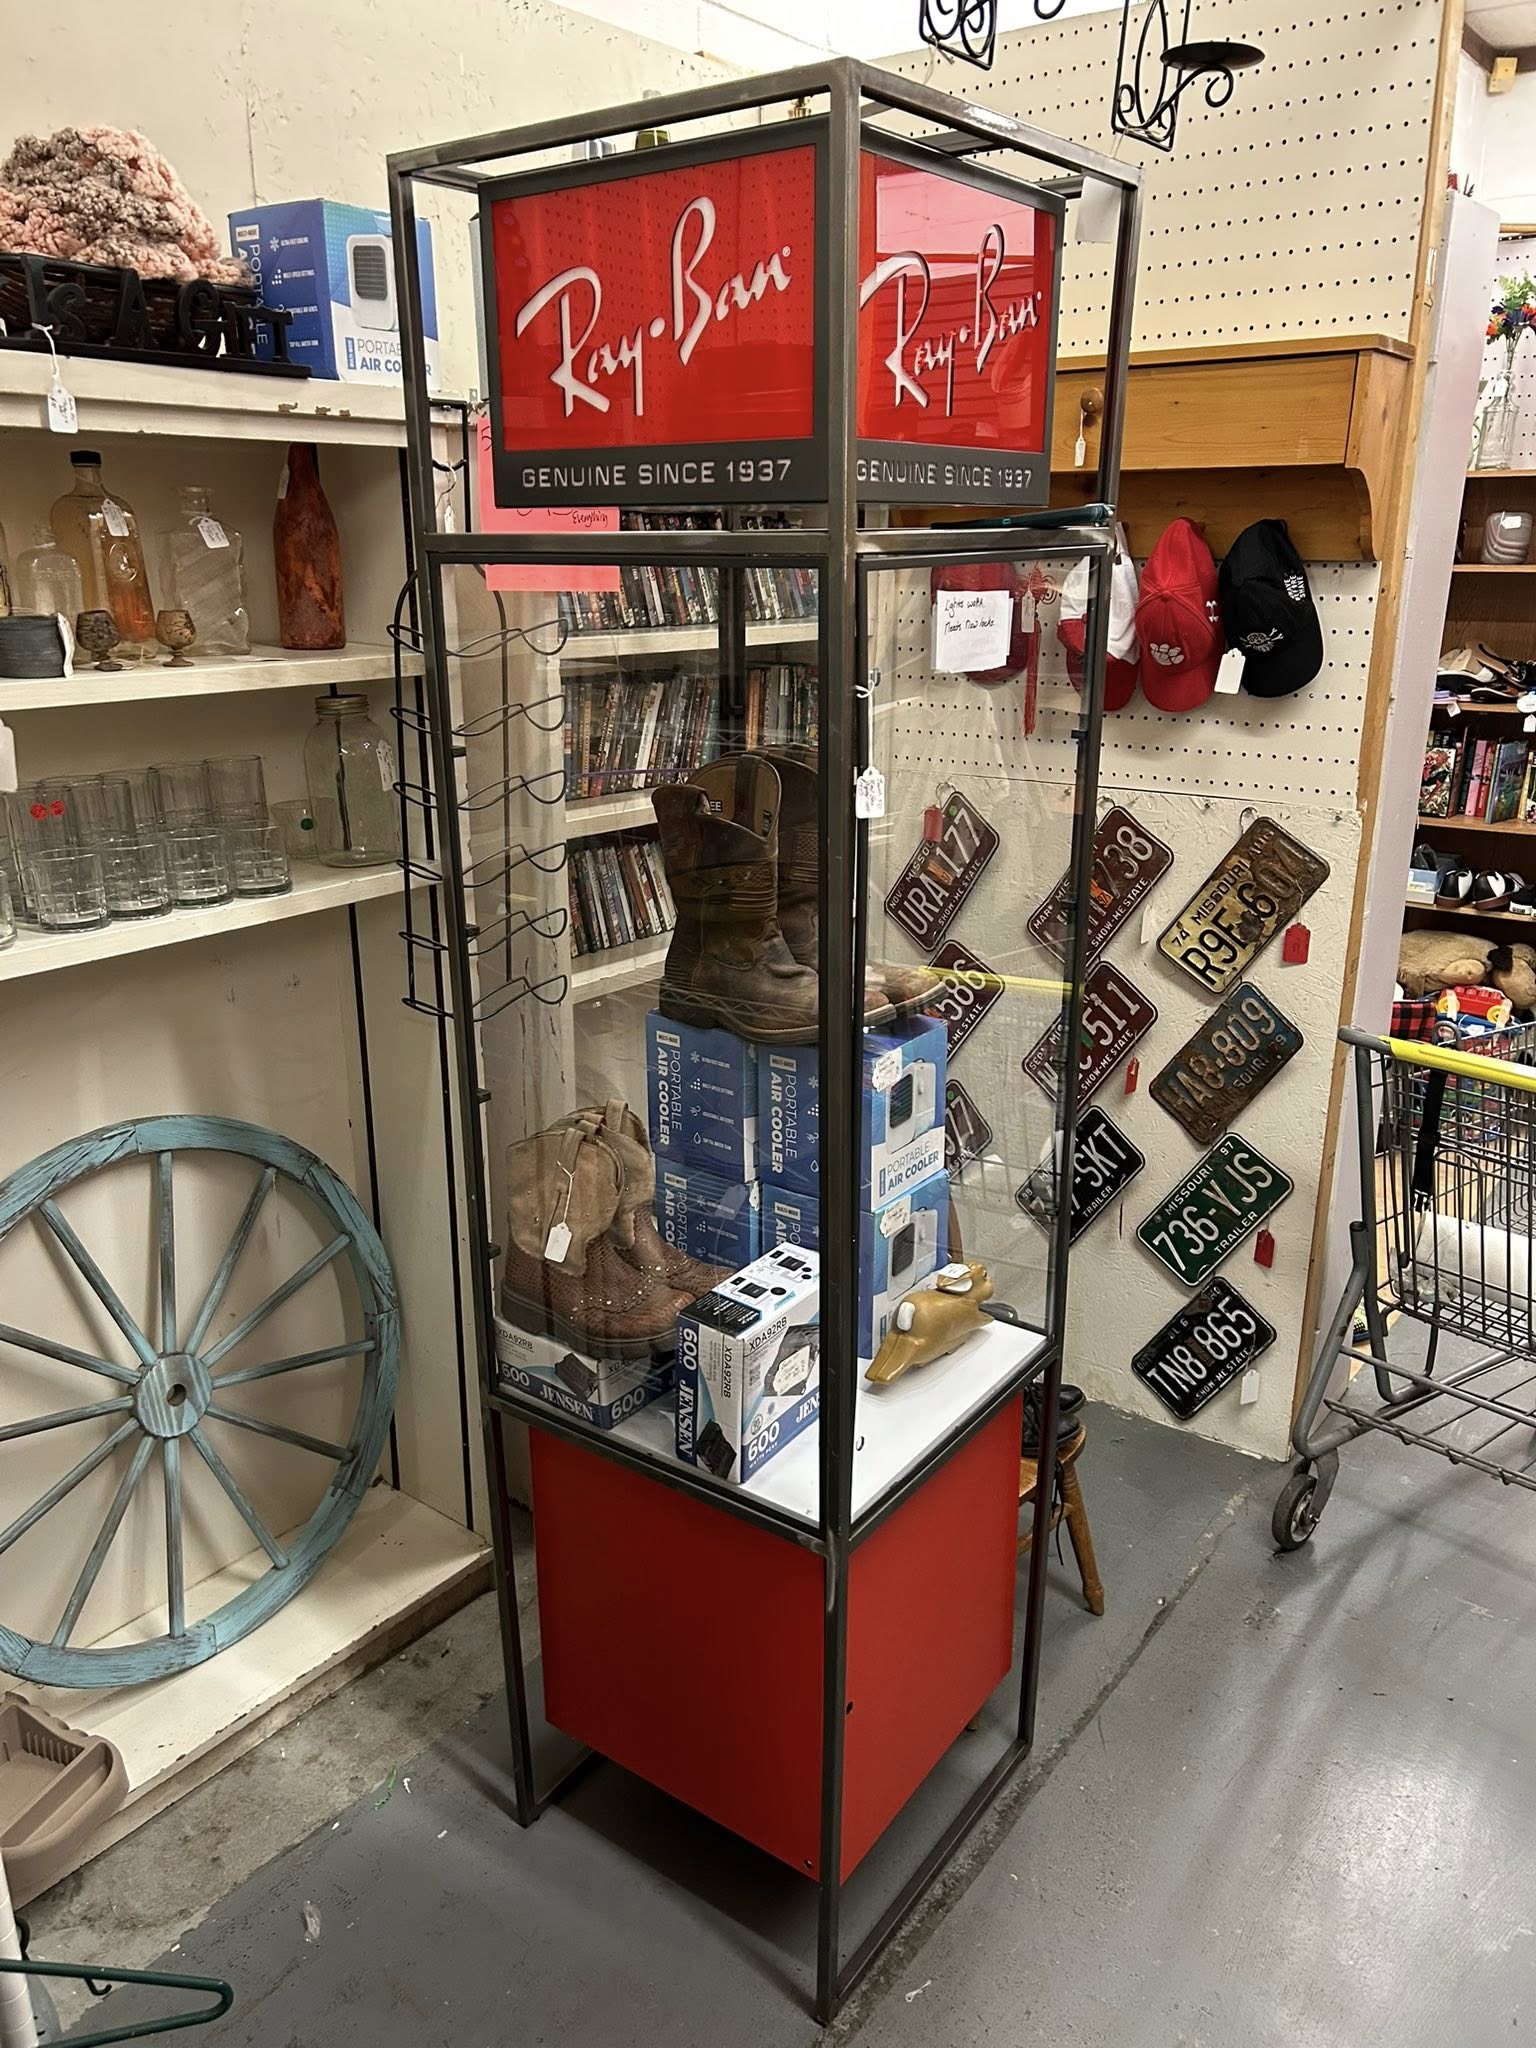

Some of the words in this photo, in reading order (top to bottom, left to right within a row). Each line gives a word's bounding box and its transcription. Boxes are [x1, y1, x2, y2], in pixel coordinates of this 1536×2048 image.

[357, 338, 401, 356] PORTAB
[360, 358, 381, 371] AIR
[522, 465, 627, 488] GENUINE
[638, 462, 715, 485] SINCE
[726, 459, 791, 482] 1937
[856, 459, 937, 485] GENUINE
[944, 465, 992, 487] SINCE
[998, 468, 1033, 488] 1937
[571, 509, 609, 528] Everything
[889, 890, 903, 909] NOV
[905, 841, 935, 883] MISSOU
[898, 872, 950, 935] URA
[936, 807, 981, 878] 177
[962, 861, 981, 888] STATE
[1033, 907, 1052, 930] MAR
[1091, 902, 1126, 947] SHOW-ME
[1122, 877, 1149, 907] STATE
[1171, 928, 1191, 947] 74
[1191, 860, 1250, 926] MISSOURI
[1179, 907, 1249, 986] R9F
[935, 959, 986, 1021] 586
[961, 1002, 984, 1030] STATE
[1082, 980, 1141, 1046] 511
[657, 1047, 668, 1077] AIR
[1029, 1048, 1044, 1071] SEP
[1081, 1053, 1113, 1091] SHOW-ME
[1110, 1028, 1134, 1056] STATE
[1160, 997, 1276, 1120] HA8-809
[658, 1080, 670, 1146] COOLER
[670, 1049, 682, 1131] PORTABLE
[771, 1071, 783, 1102] AIR
[771, 1105, 784, 1174] COOLER
[784, 1074, 797, 1159] PORTABLE
[887, 1141, 931, 1176] PORTABLE
[888, 1175, 904, 1191] AIR
[905, 1150, 939, 1179] COOLER
[1164, 1163, 1214, 1216] MISSOURI
[1219, 1140, 1235, 1156] 97
[665, 1188, 675, 1217] AIR
[676, 1191, 688, 1252] PORTAB
[1082, 1185, 1113, 1218] TRAILER
[1152, 1152, 1273, 1272] 736-YJS
[1213, 1210, 1259, 1254] TRAILER
[683, 1328, 697, 1371] 600
[749, 1316, 788, 1351] XDA92RB
[1147, 1345, 1207, 1401] TN8
[1193, 1296, 1256, 1361] 865
[502, 1362, 530, 1387] 600
[540, 1384, 594, 1422] JENSEN
[722, 1345, 733, 1398] XDA92RB
[1195, 1367, 1229, 1399] SHOW-ME
[1226, 1347, 1249, 1372] STATE
[611, 1387, 646, 1420] 600
[679, 1380, 695, 1457] JENSEN
[749, 1421, 780, 1461] 600
[796, 1391, 820, 1424] JEN
